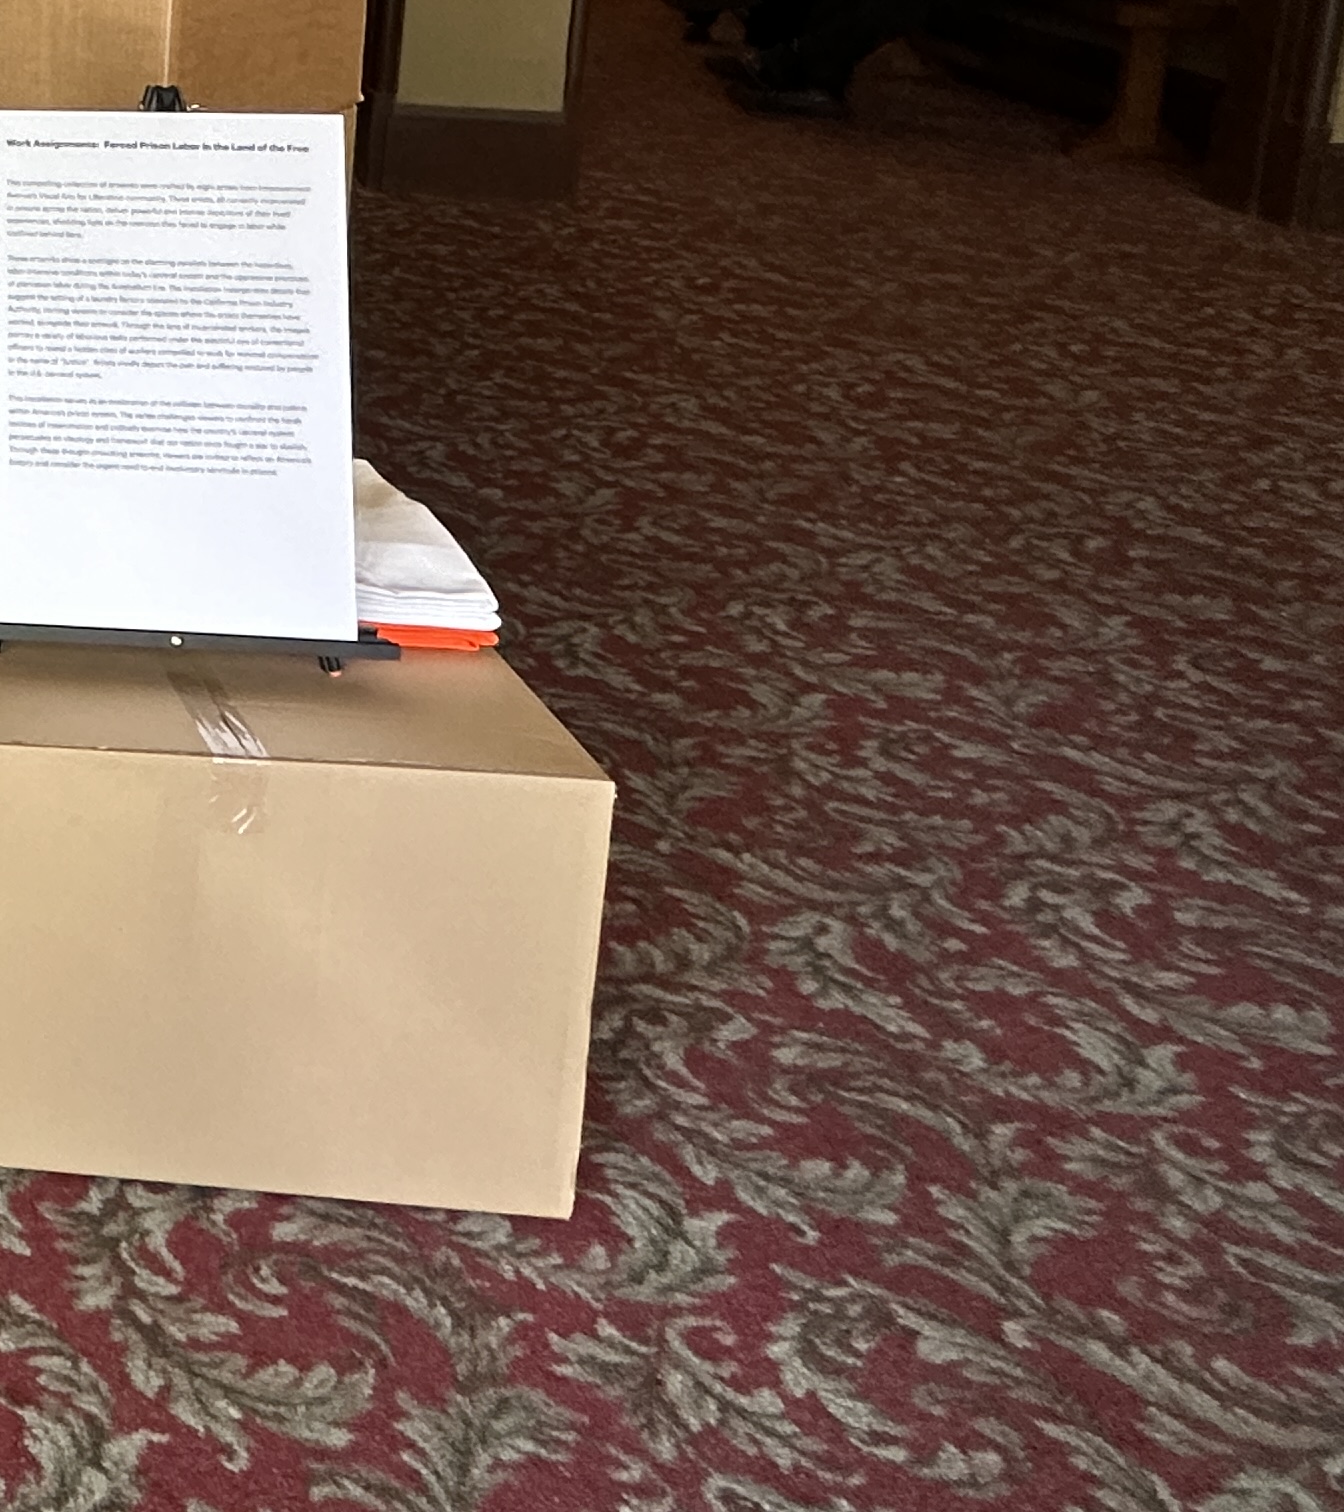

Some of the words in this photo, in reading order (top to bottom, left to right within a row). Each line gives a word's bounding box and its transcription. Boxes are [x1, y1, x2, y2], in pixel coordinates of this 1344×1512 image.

[6, 139, 32, 148] Work
[103, 140, 138, 150] Forced
[139, 141, 172, 151] Prison
[172, 142, 201, 151] Labor
[202, 142, 212, 151] in
[213, 142, 230, 152] the
[230, 143, 256, 152] Land
[257, 143, 268, 152] of
[269, 144, 286, 153] the
[286, 144, 310, 154] Free
